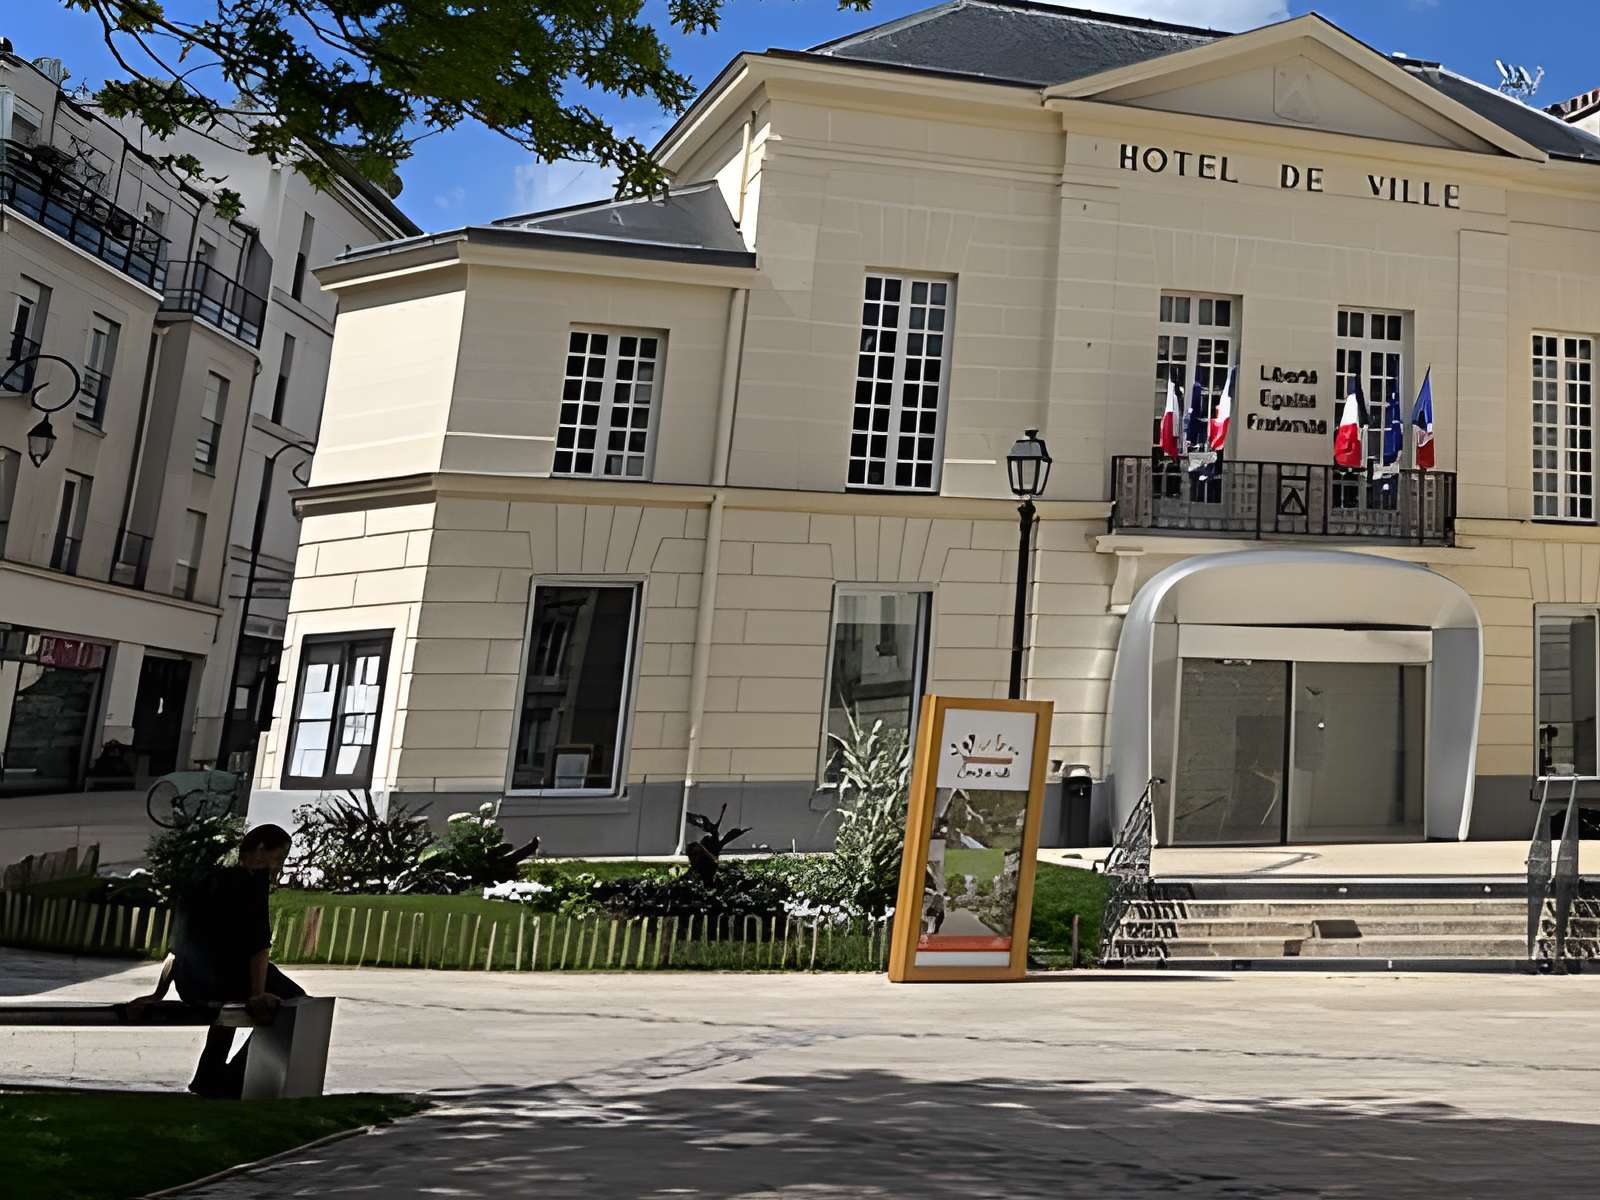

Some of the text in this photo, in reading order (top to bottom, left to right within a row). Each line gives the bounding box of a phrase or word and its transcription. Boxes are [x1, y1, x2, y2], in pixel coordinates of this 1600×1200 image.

[1120, 144, 1461, 210] HOTEL DE VILLE
